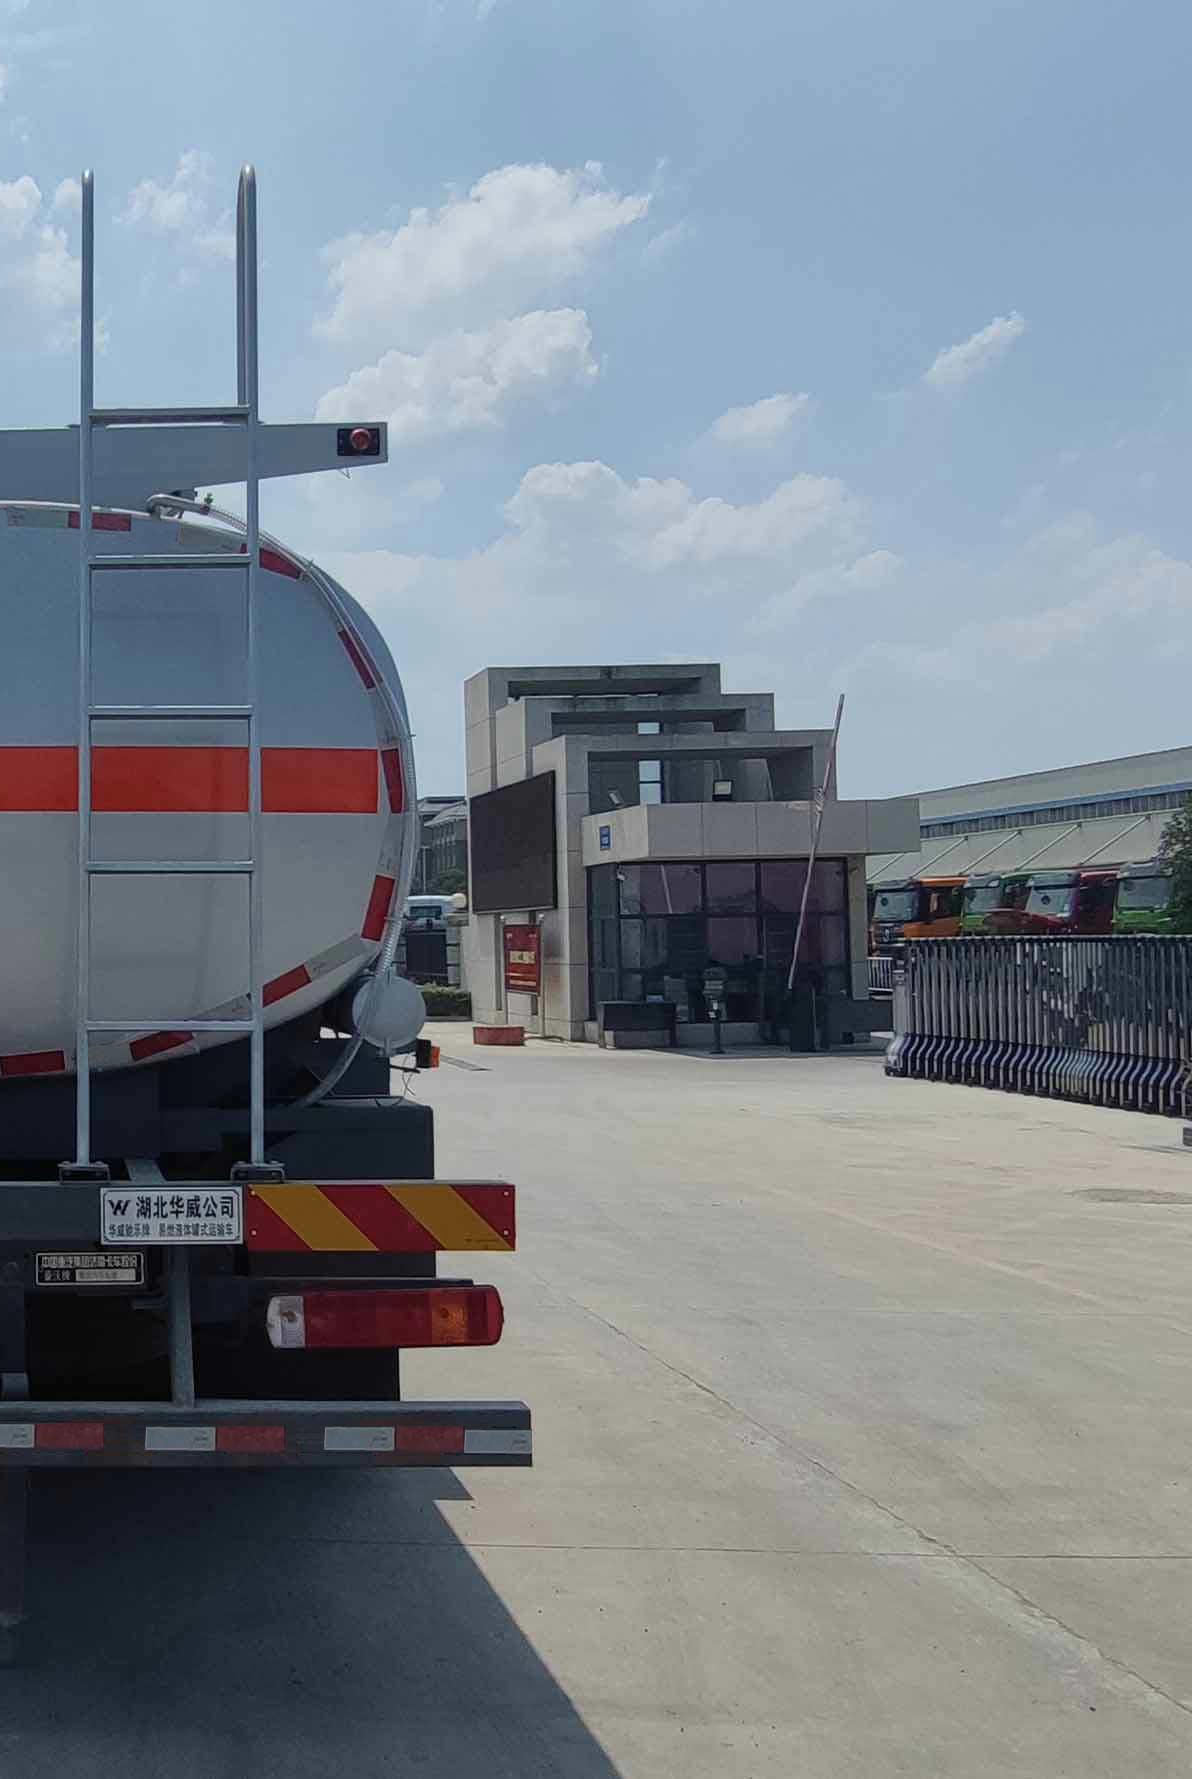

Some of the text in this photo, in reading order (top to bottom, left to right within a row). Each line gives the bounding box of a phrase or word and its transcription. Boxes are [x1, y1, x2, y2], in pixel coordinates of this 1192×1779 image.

[135, 1195, 234, 1218] 湖北华威公司
